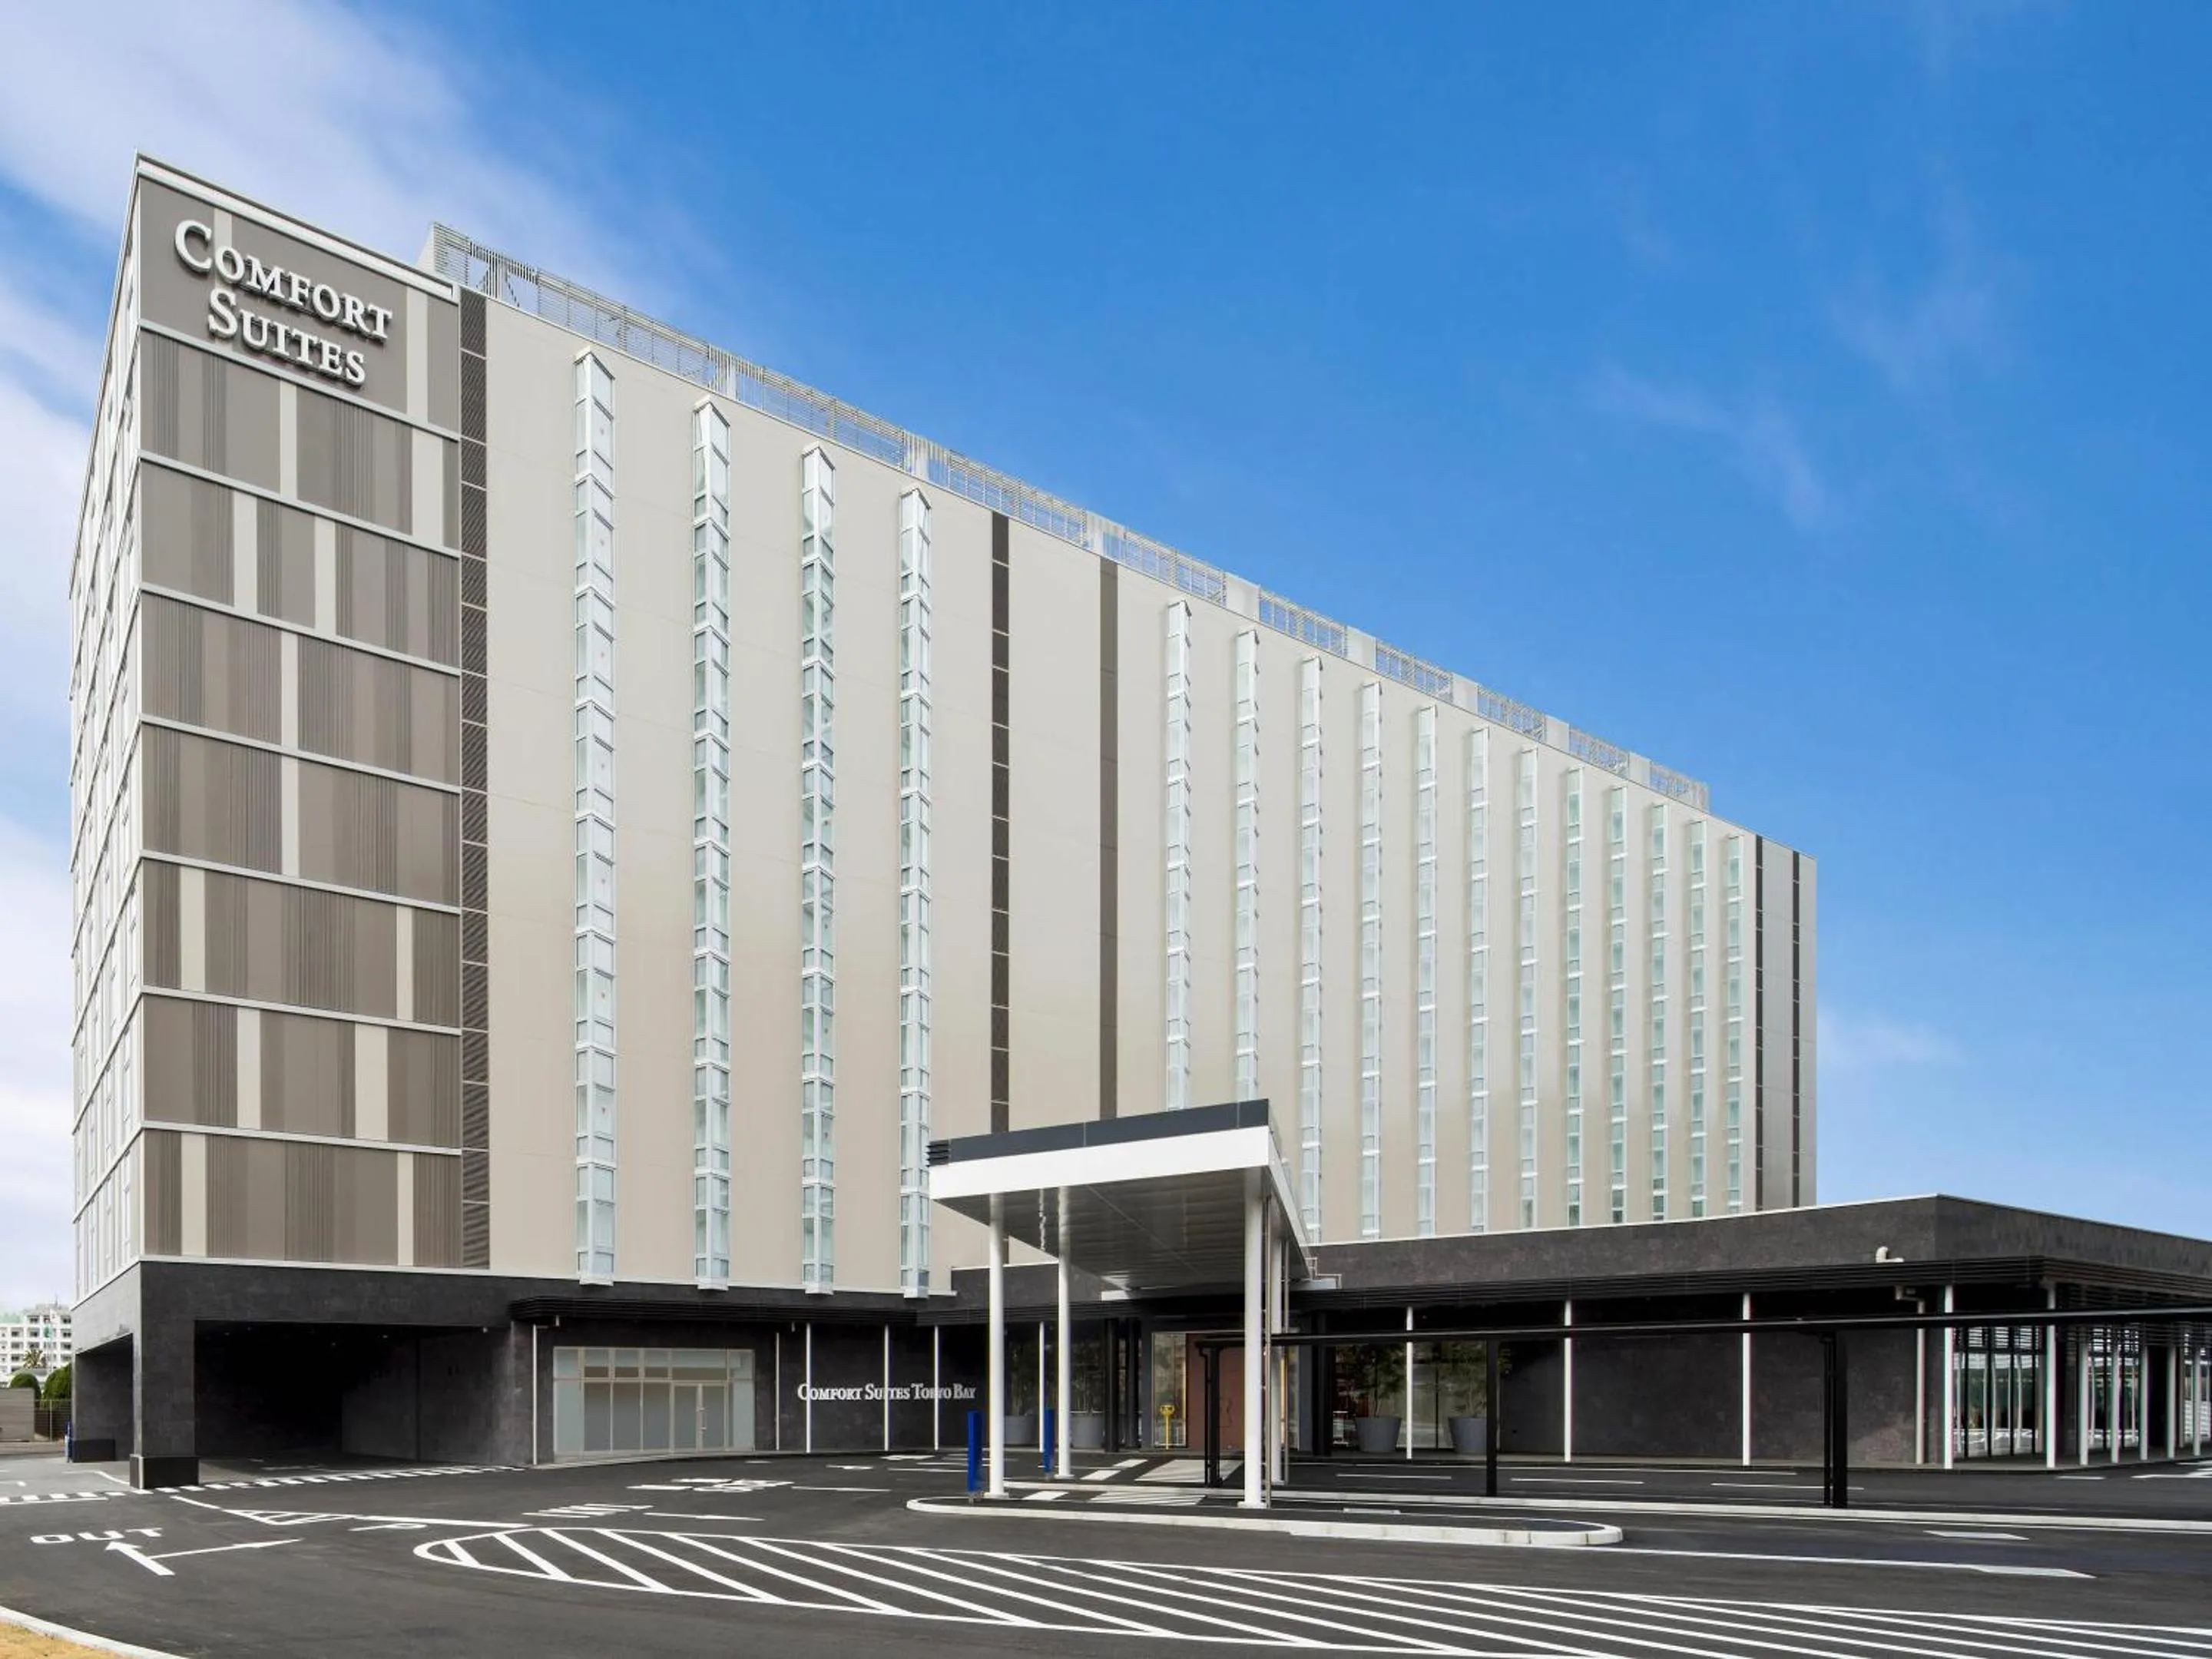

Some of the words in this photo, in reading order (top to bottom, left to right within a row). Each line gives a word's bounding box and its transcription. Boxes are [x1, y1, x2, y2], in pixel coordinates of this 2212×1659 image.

[174, 220, 392, 343] COMFORT
[208, 288, 366, 386] SUITES
[953, 1383, 976, 1399] BAY
[30, 1528, 163, 1544] OUT
